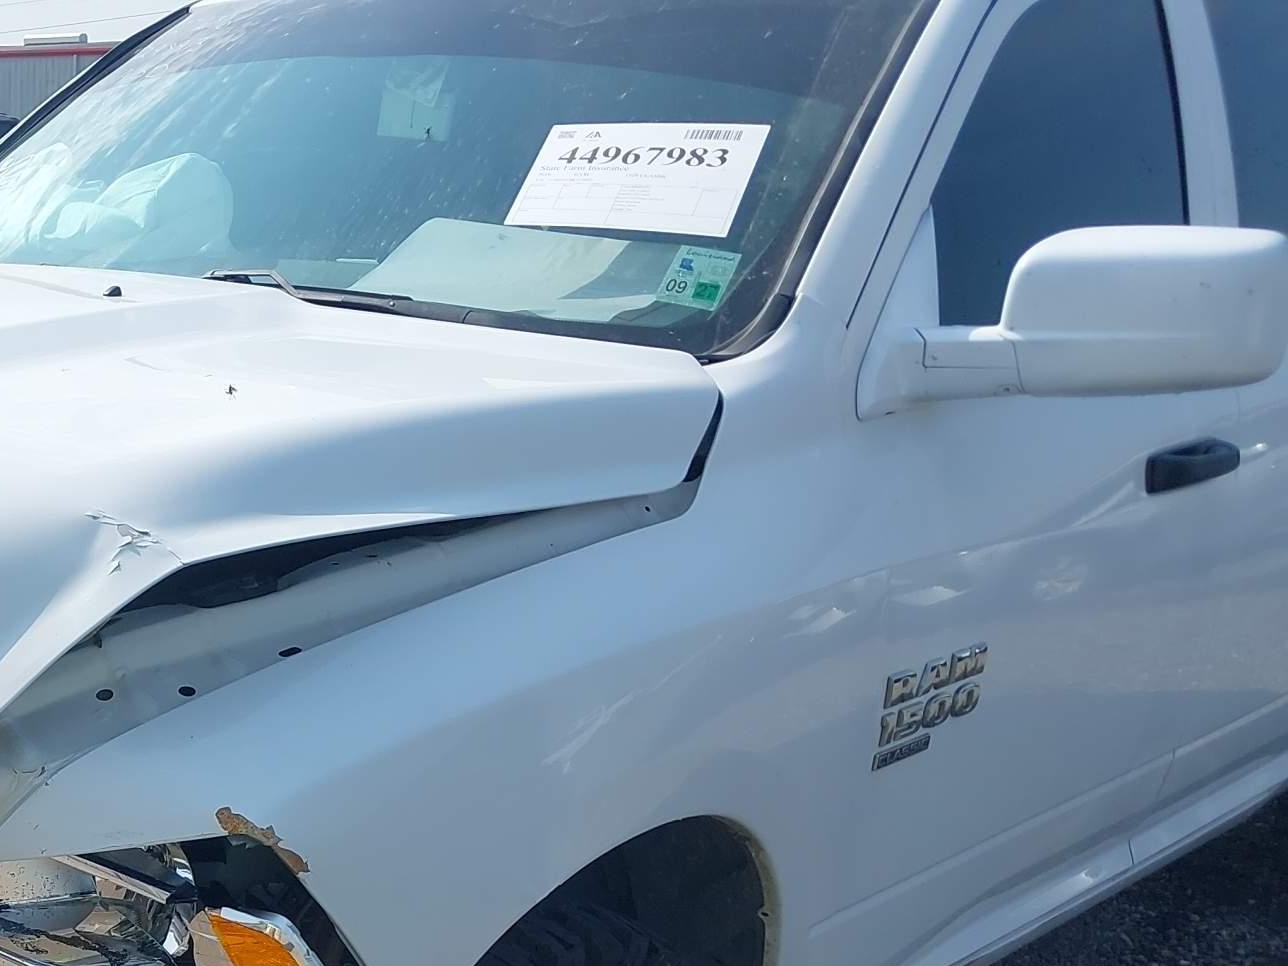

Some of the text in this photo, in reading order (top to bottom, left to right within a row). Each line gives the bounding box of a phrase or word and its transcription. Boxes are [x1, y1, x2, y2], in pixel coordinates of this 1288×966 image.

[558, 146, 731, 168] 44967983
[665, 278, 688, 294] 09
[884, 642, 988, 709] RAM
[878, 682, 981, 747] 1500
[876, 735, 930, 769] CLASSIC
